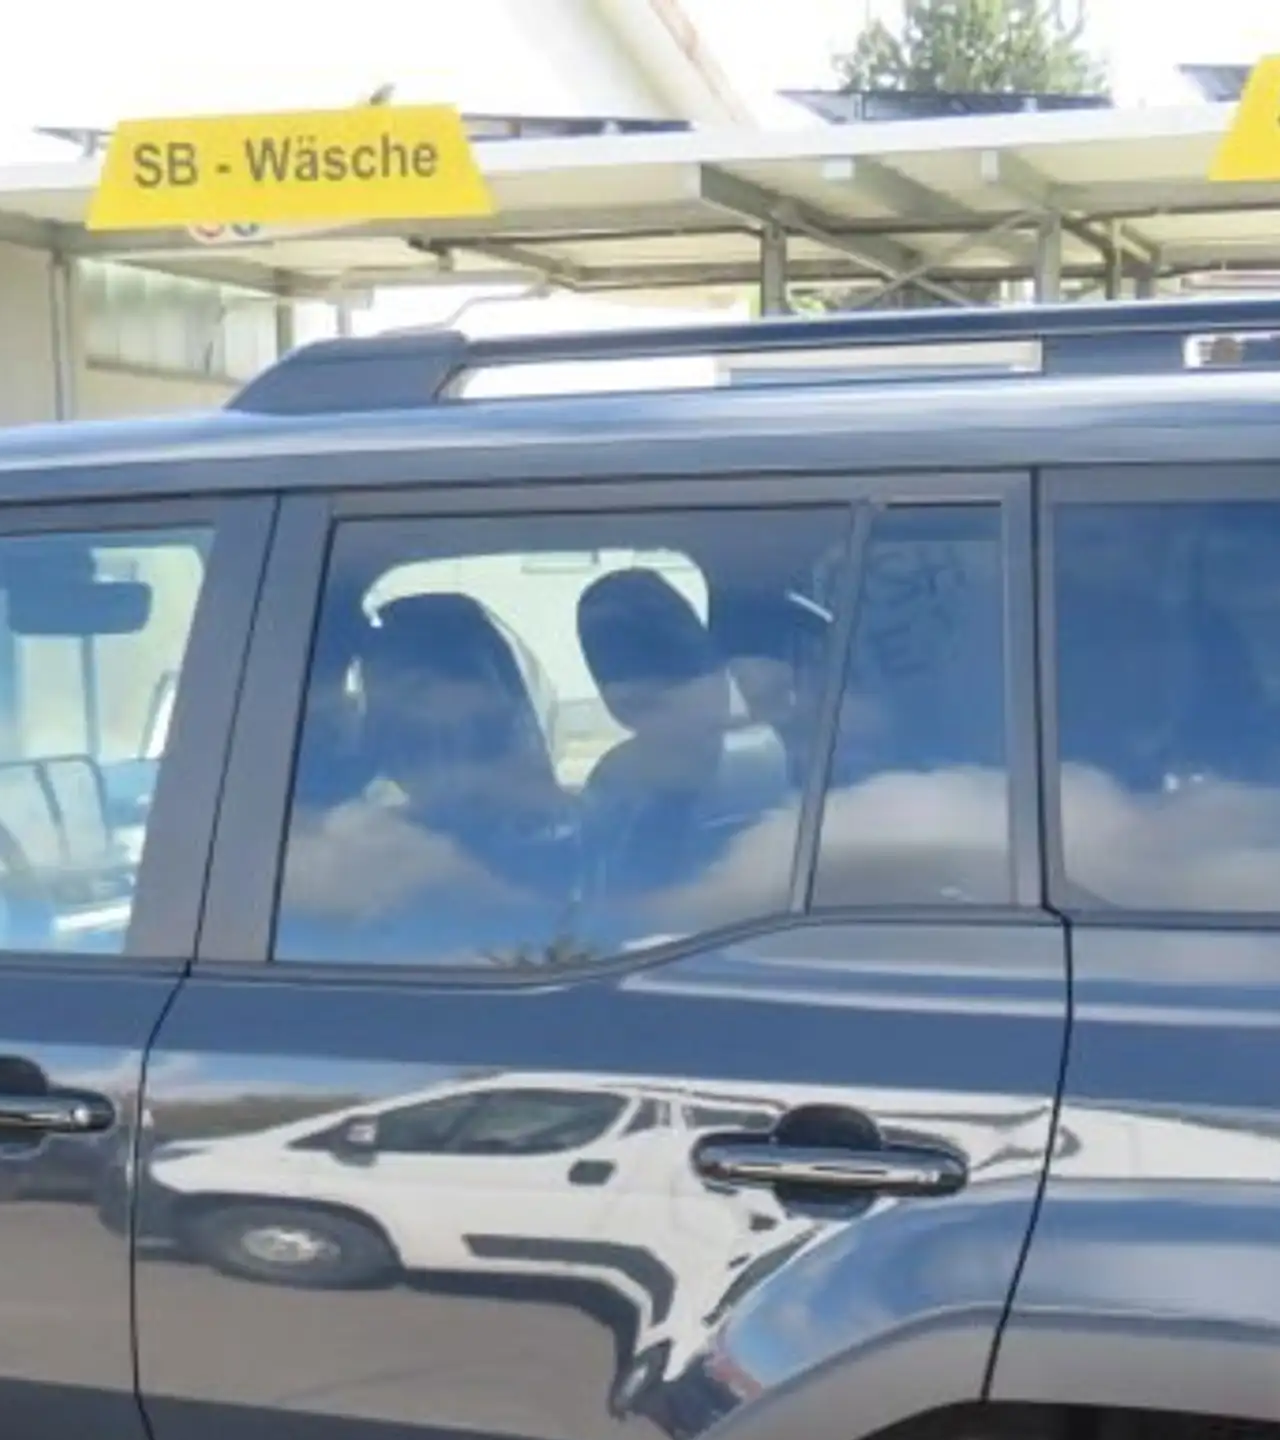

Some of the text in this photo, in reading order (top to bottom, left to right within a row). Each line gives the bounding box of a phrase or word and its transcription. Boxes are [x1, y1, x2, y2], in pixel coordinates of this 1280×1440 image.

[133, 134, 439, 188] SB - Wäsche
